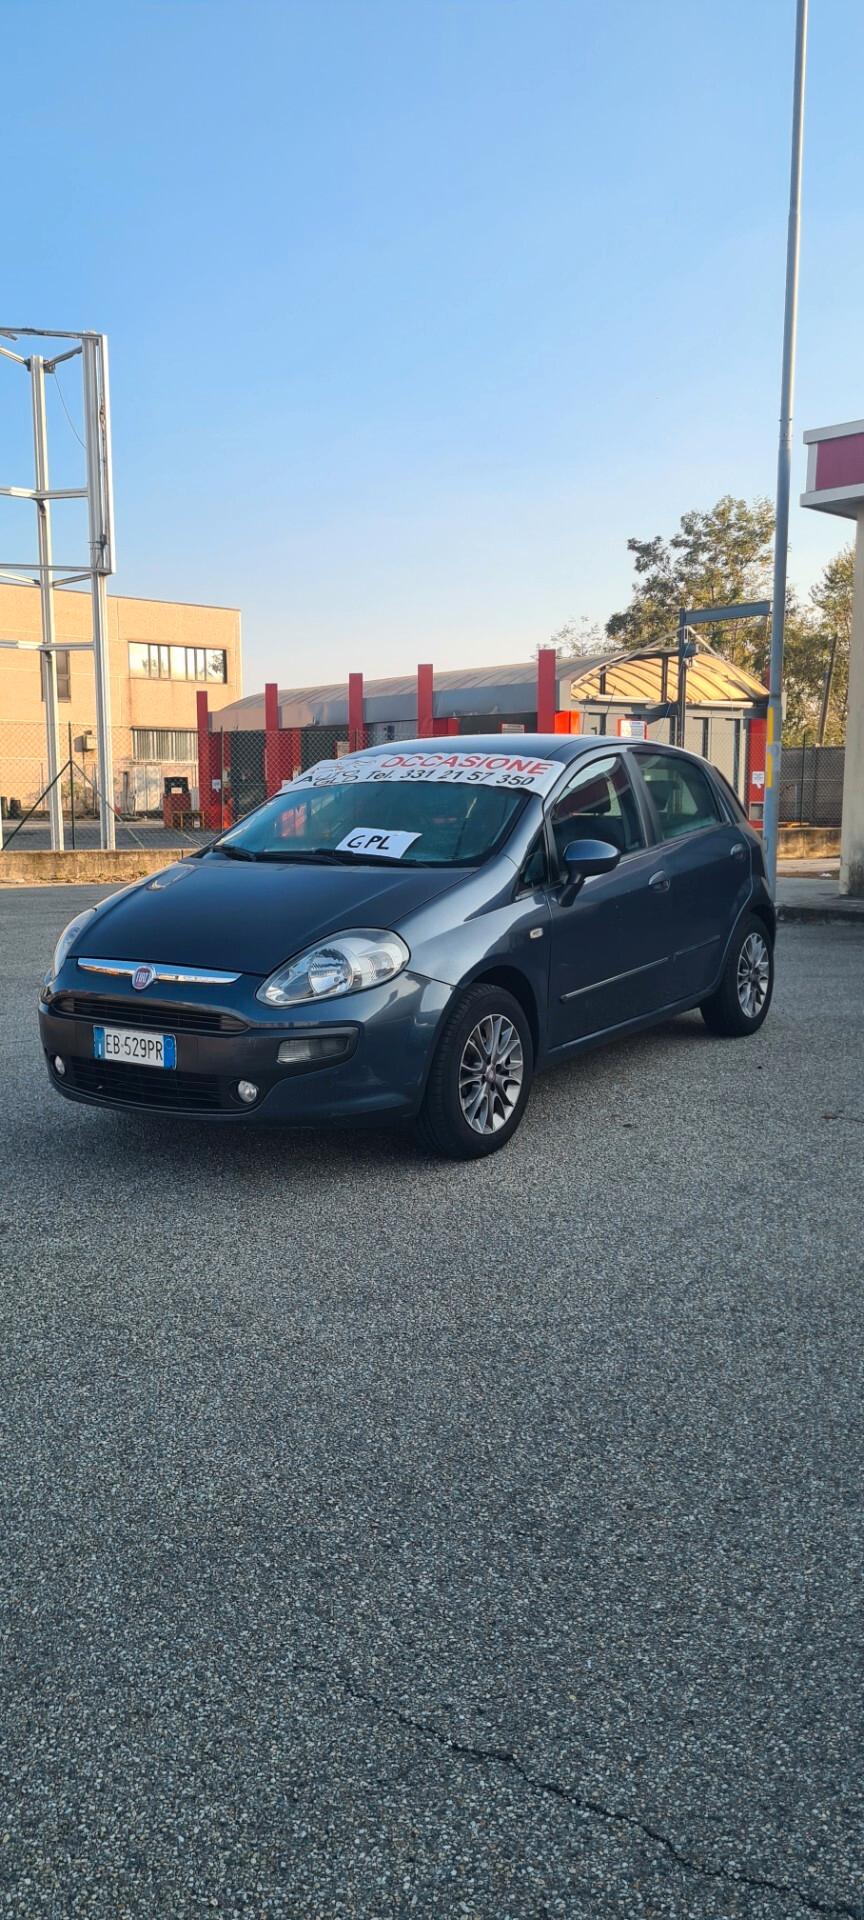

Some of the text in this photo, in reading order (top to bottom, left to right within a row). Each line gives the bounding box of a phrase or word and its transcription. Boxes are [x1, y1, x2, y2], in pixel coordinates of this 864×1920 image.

[380, 755, 554, 775] OCCASIONE
[365, 769, 392, 780] Tel.
[400, 769, 435, 779] 331
[438, 770, 465, 780] 21
[467, 771, 495, 782] 57
[496, 774, 536, 786] 350
[346, 834, 391, 850] GPL
